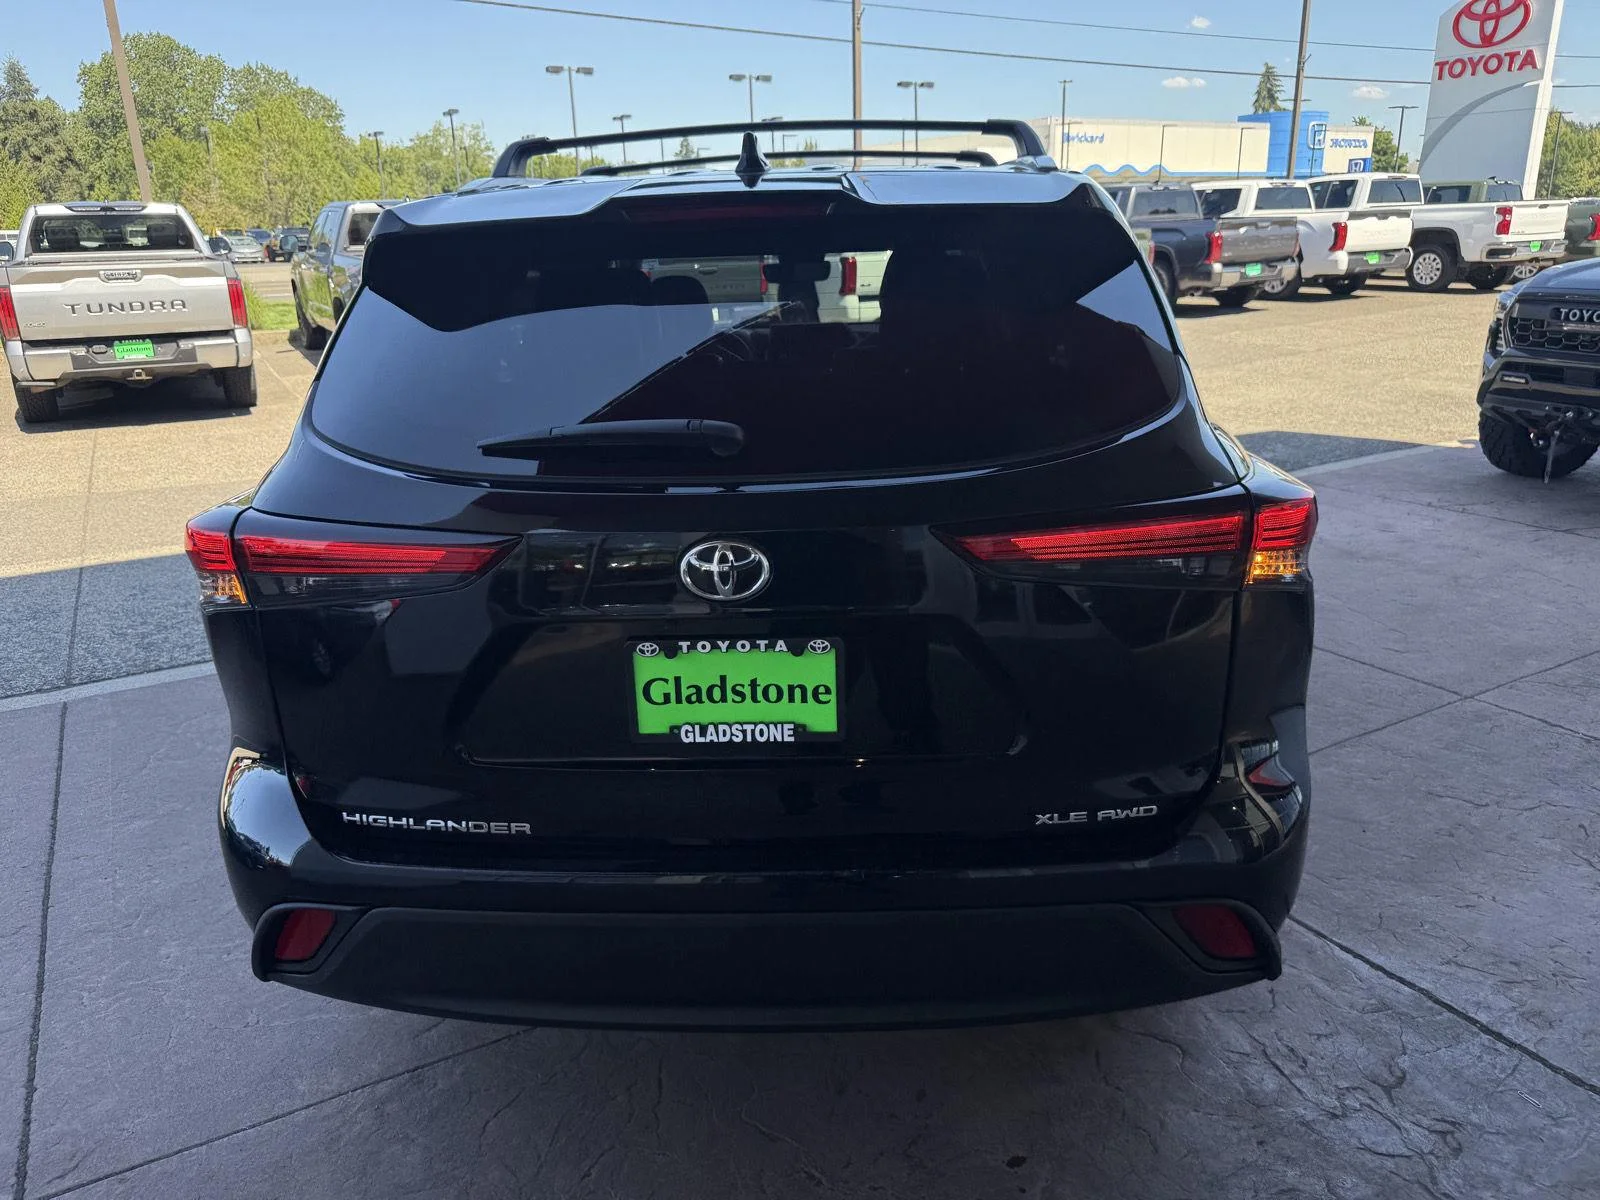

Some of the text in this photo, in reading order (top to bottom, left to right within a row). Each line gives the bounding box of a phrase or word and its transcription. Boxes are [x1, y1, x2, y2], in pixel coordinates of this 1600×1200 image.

[1434, 49, 1539, 81] TOYOTA
[64, 299, 188, 317] TUNDRA
[678, 639, 789, 654] TOYOTA
[642, 674, 833, 706] Gladstone
[680, 723, 795, 743] GLADSTONE
[342, 811, 532, 834] HIGHLANDER
[1035, 805, 1158, 825] XLE AWD
